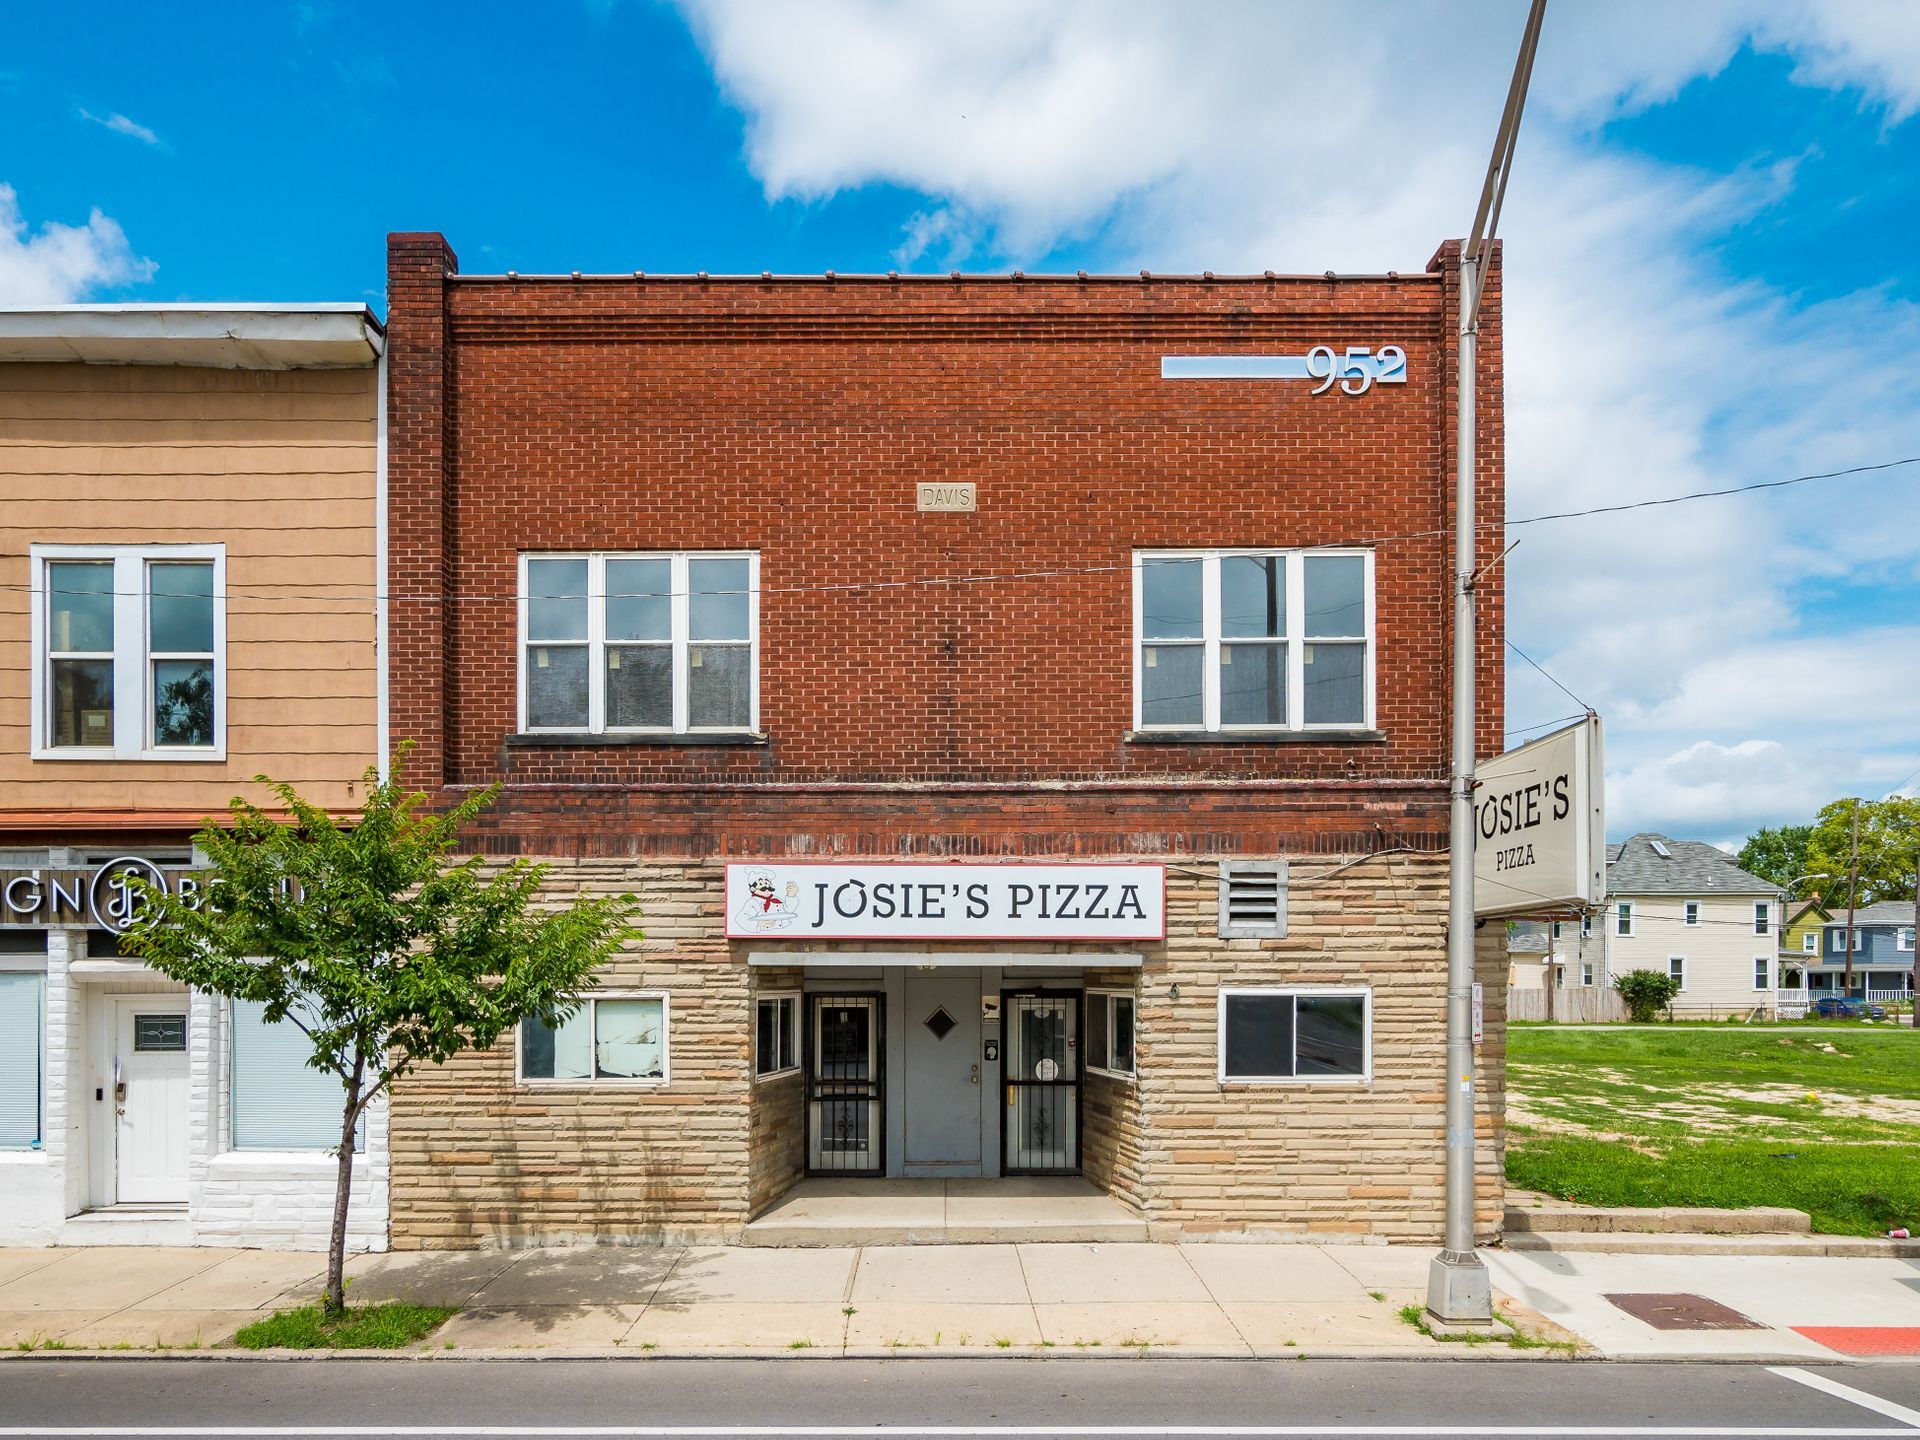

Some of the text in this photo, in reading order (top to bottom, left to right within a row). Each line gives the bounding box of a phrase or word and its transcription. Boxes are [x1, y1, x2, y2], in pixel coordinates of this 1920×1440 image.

[1306, 345, 1407, 395] 952
[923, 488, 970, 506] DAVIS
[1496, 843, 1535, 871] PIZZA
[811, 878, 1146, 928] JOSIE'S PIZZA
